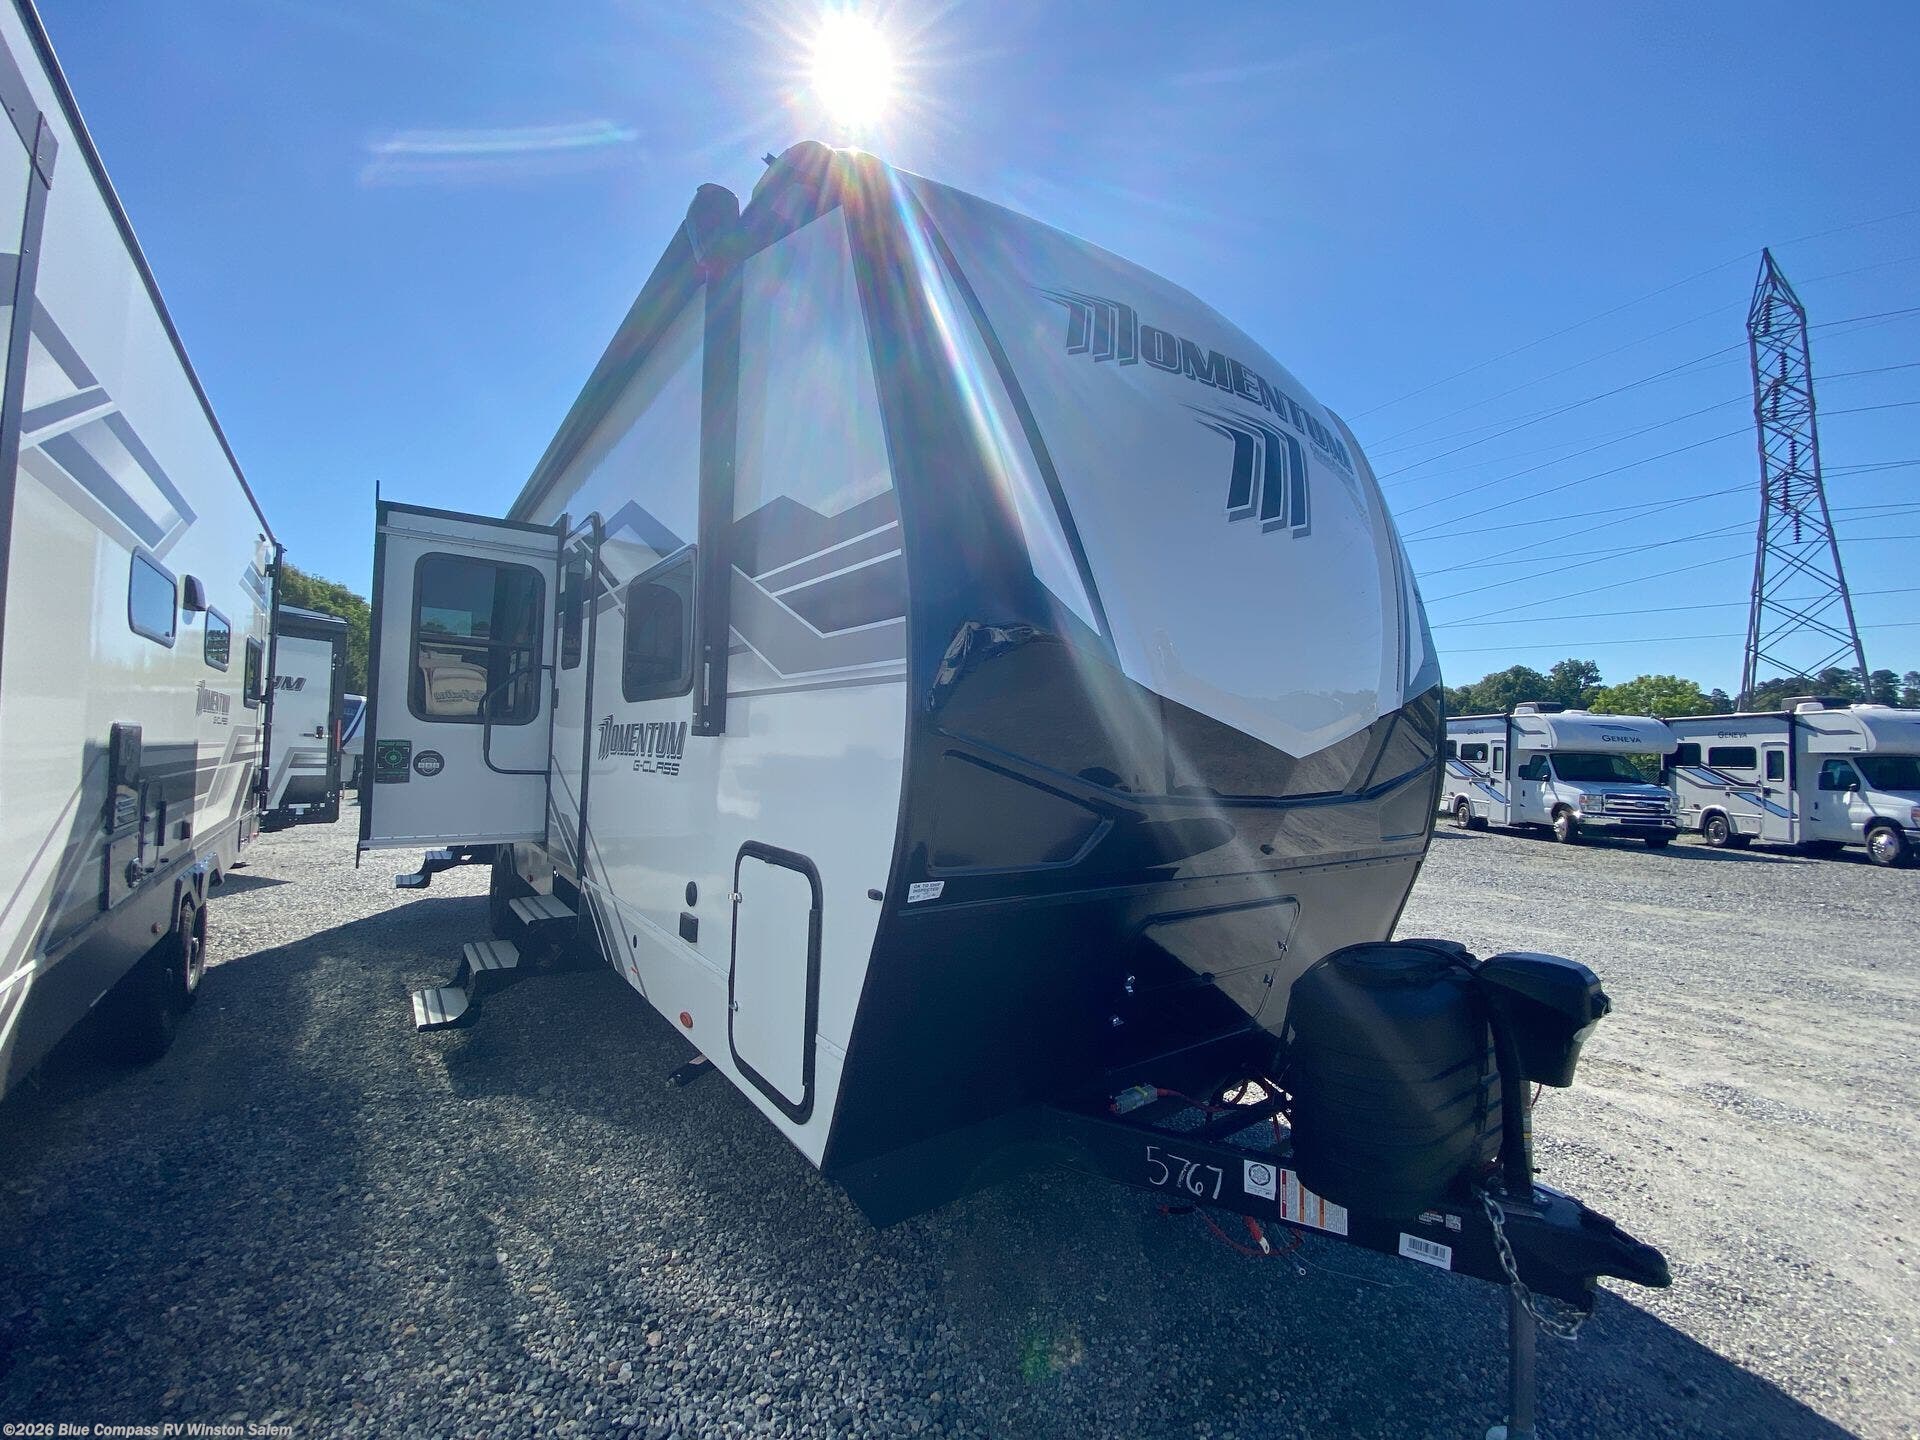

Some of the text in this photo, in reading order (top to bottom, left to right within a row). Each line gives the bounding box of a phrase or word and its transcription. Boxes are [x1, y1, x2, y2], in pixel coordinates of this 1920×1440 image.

[1031, 286, 1354, 476] MOMENTUM
[598, 712, 688, 760] MOMENTUM
[1601, 734, 1642, 744] GENEVA
[633, 760, 680, 776] G-CLASS
[1146, 1145, 1224, 1200] 5767
